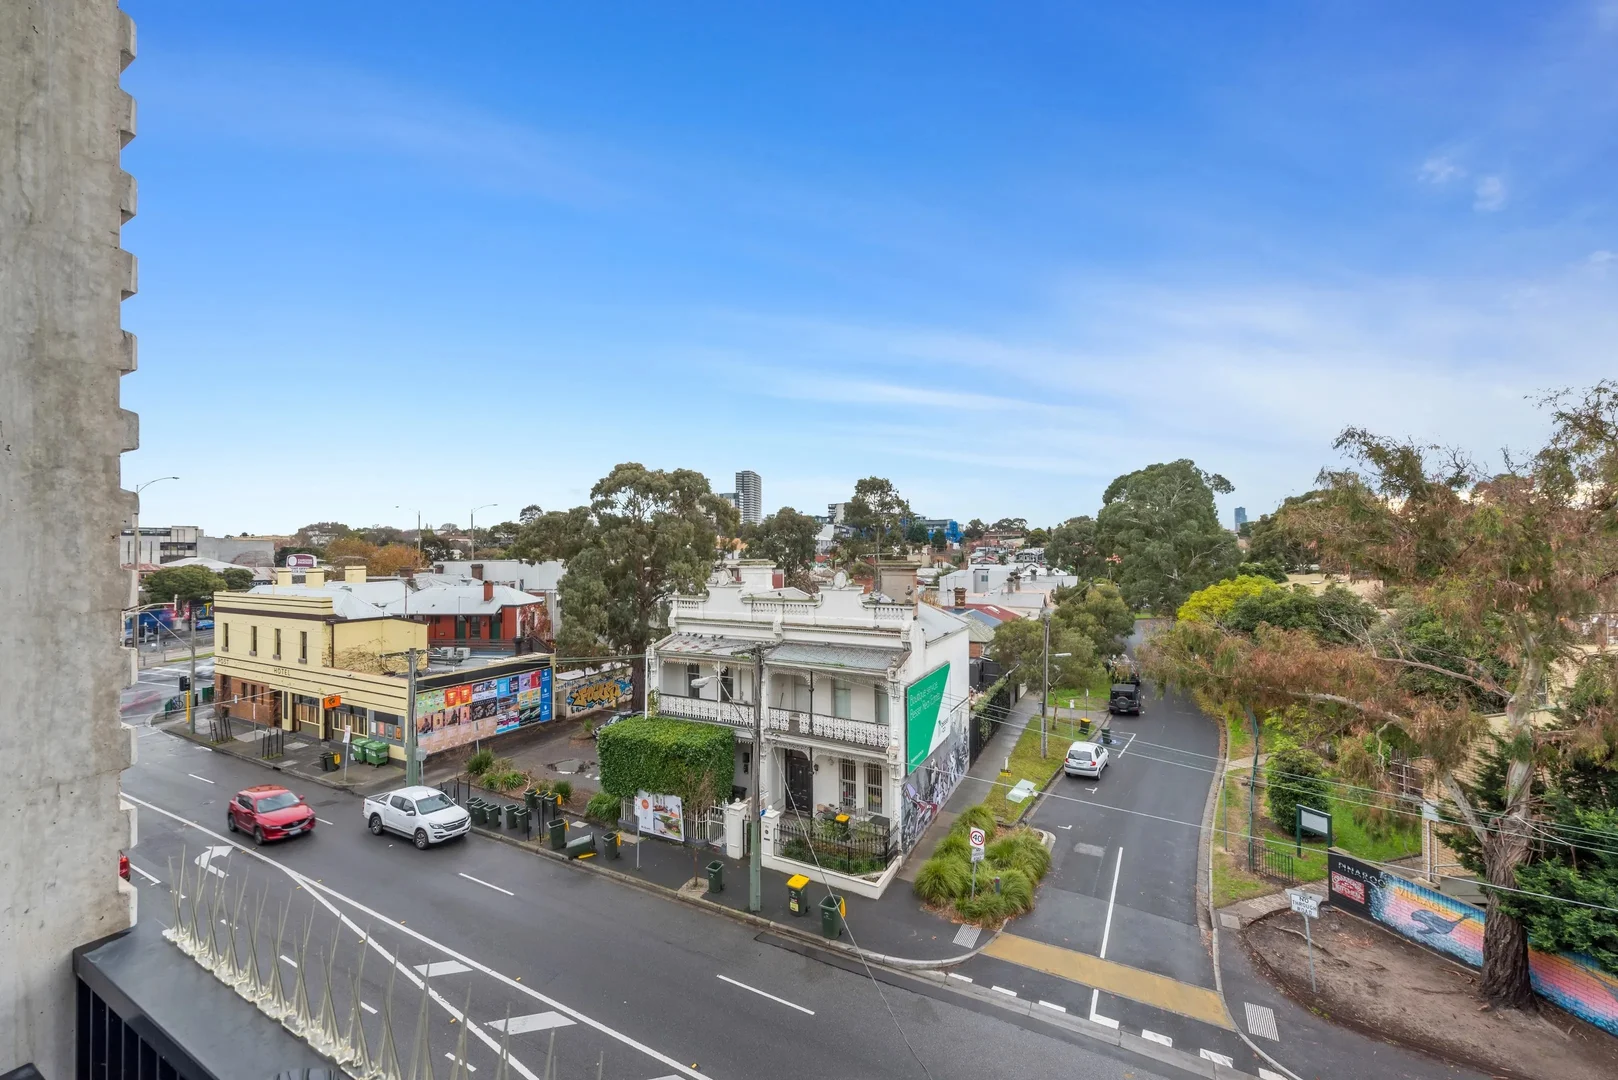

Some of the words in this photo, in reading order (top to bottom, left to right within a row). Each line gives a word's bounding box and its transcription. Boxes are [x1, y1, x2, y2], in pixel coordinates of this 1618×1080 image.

[273, 667, 291, 677] HOTEL
[972, 834, 983, 843] 40
[1299, 895, 1309, 904] NO
[1292, 899, 1317, 911] THROUGH
[1296, 906, 1313, 916] ROAD
